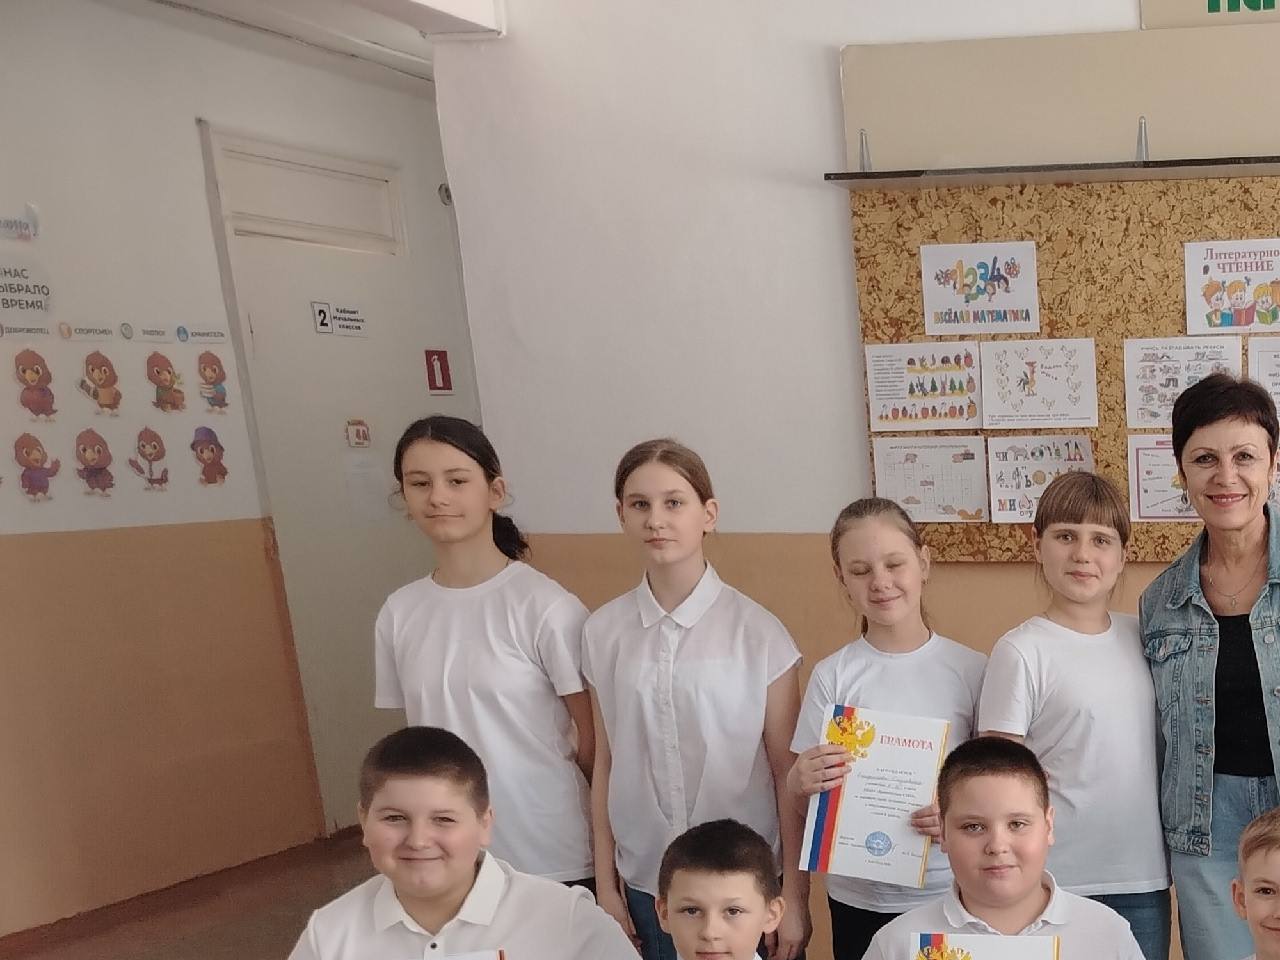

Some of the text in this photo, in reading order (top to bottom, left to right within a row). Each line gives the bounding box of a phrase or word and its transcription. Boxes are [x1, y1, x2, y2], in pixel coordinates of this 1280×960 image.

[1217, 260, 1275, 273] ЧТЕНИЕ
[4, 268, 29, 279] НАС
[0, 284, 50, 296] ЫБРАЛО
[1, 298, 44, 311] ВРЕМЯ
[318, 309, 329, 327] 2
[973, 309, 1031, 323] МАТЕМАТИКА
[880, 735, 934, 751] ГРАМОТА
